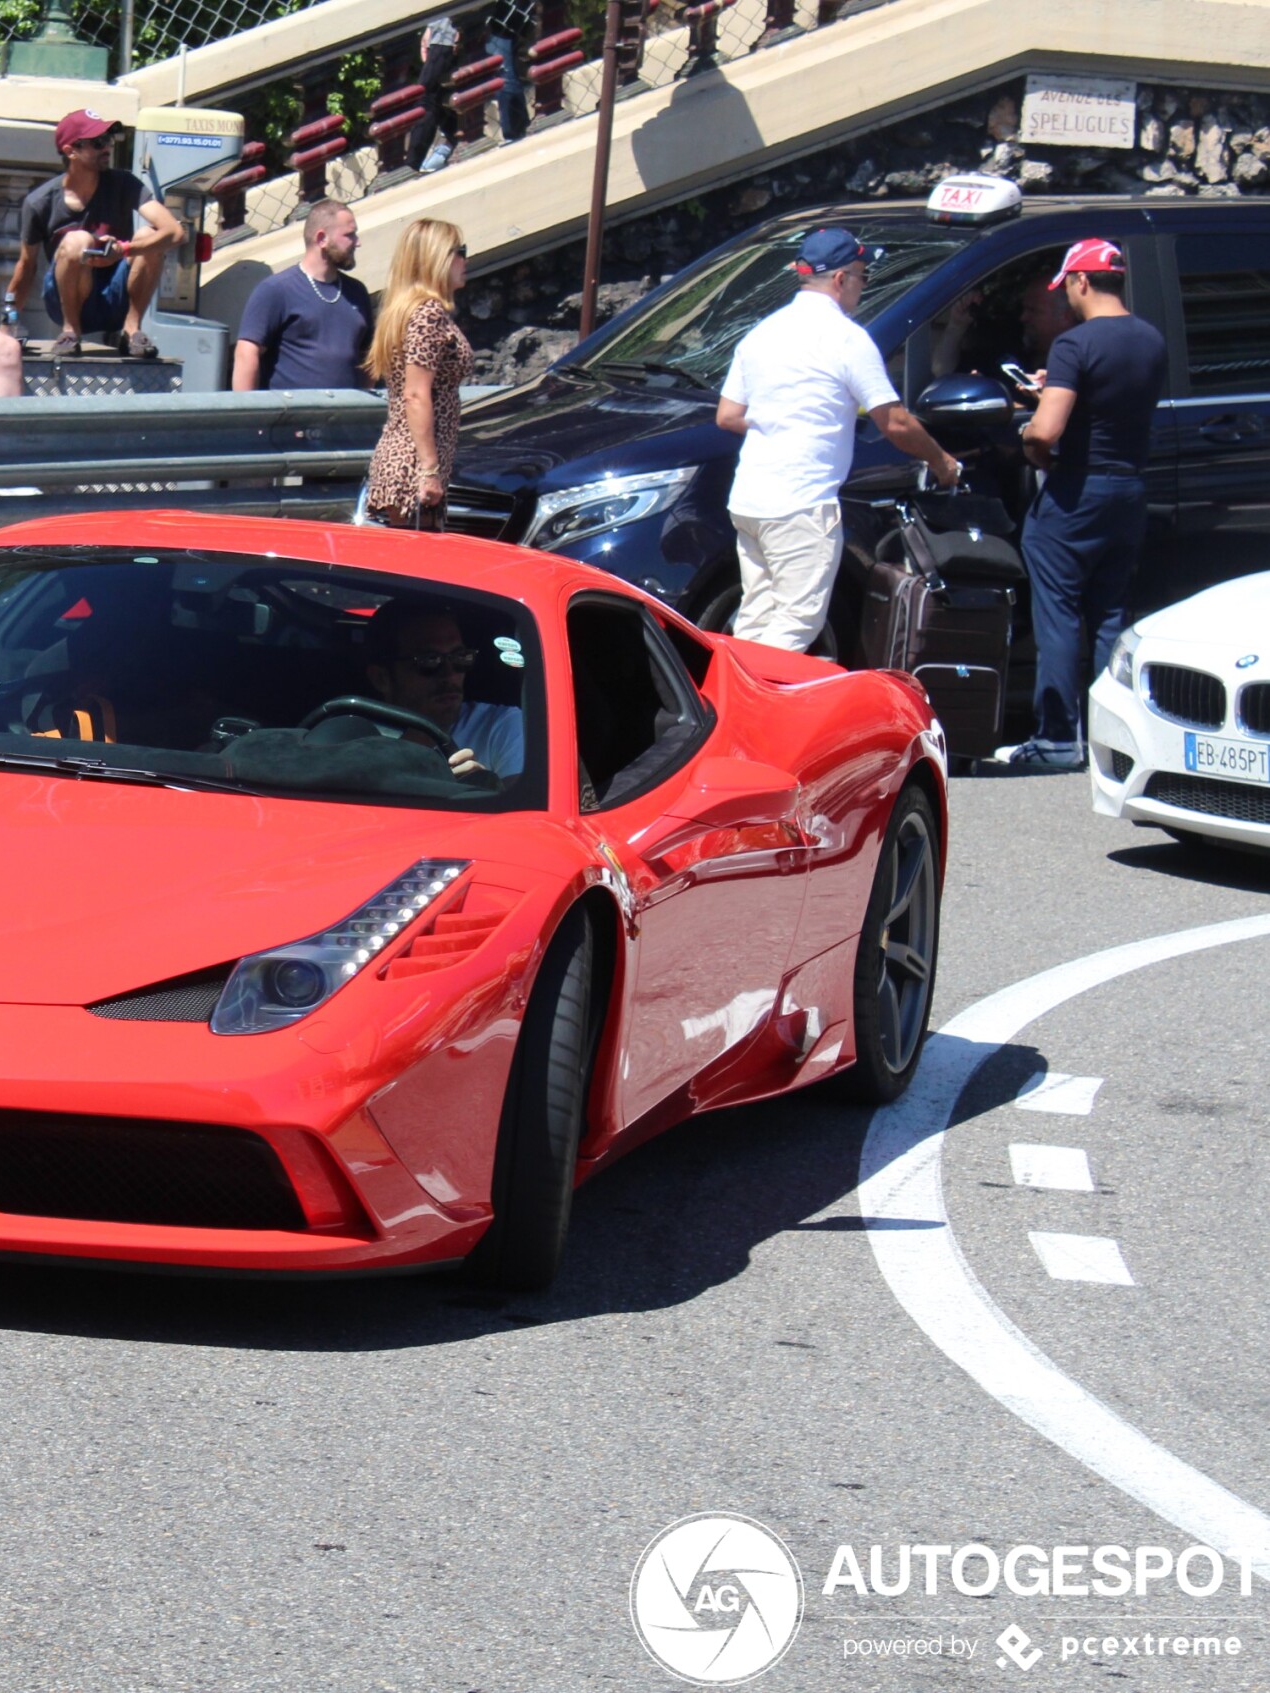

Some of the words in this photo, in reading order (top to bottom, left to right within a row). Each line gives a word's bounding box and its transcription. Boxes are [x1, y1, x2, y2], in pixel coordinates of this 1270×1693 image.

[1041, 90, 1092, 104] AVENUE
[1097, 92, 1122, 106] DES
[185, 118, 215, 132] TAXIS
[1029, 111, 1130, 135] SPELUGUES
[941, 188, 983, 204] TAXI
